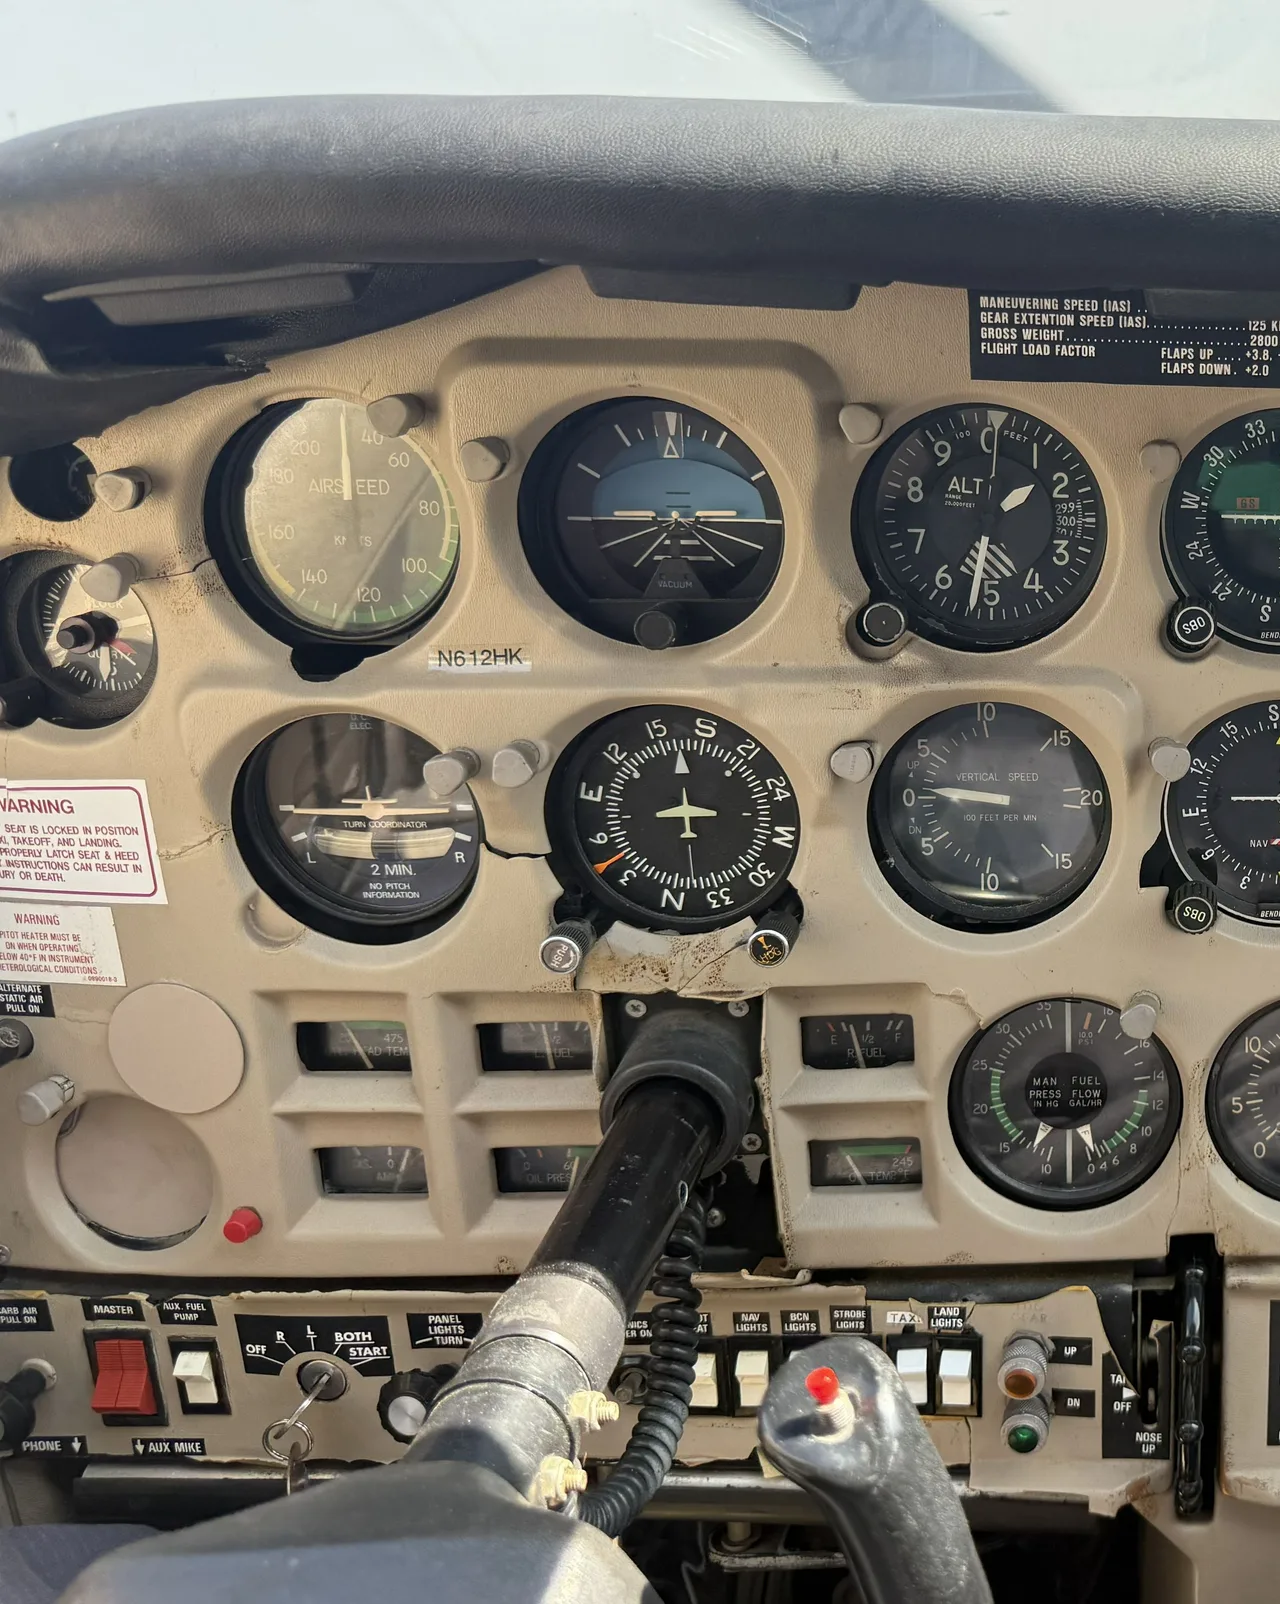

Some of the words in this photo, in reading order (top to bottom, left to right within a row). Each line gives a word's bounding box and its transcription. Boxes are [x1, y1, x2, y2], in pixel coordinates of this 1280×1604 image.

[980, 296, 1058, 310] MANEUVERING
[1064, 300, 1098, 311] SPEED
[1103, 300, 1130, 312] (IAS)
[980, 312, 1010, 324] GEAR
[1014, 313, 1075, 326] EXTENTION
[1080, 315, 1114, 327] SPEED
[1249, 321, 1267, 332] 125
[981, 327, 1017, 340] GROSS
[1022, 329, 1064, 341] WEIGHT
[1251, 335, 1279, 347] 2800
[981, 343, 1017, 355] FLIGHT
[1022, 344, 1051, 356] LOAD
[1055, 345, 1095, 357] FACTOR
[1161, 348, 1194, 360] FLAPS
[1200, 349, 1214, 360] UP
[1161, 363, 1194, 374] FLAPS
[1246, 365, 1269, 376] +2.0
[948, 476, 983, 494] ALT
[438, 648, 522, 667] N612HK
[956, 773, 999, 782] VERTICAL
[1008, 773, 1038, 782] SPEED
[5, 824, 26, 834] SEAT
[30, 826, 38, 834] IS
[42, 826, 79, 835] LOCKED
[83, 827, 92, 835] IN
[95, 826, 138, 836] POSITION
[372, 864, 380, 875] 2
[385, 864, 416, 875] MIN.
[14, 913, 60, 926] WARNING
[7, 1004, 25, 1012] PULL
[29, 1005, 40, 1013] ON
[1033, 1077, 1057, 1086] MAN
[1072, 1076, 1100, 1085] FUEL
[1029, 1090, 1062, 1099] PRESS
[1072, 1090, 1101, 1098] FLOW
[94, 1304, 133, 1315] MASTER
[742, 1313, 760, 1322] NAV
[736, 1323, 768, 1333] LIGHTS
[335, 1331, 372, 1342] BOTH
[349, 1346, 388, 1356] START
[22, 1441, 61, 1451] PHONE
